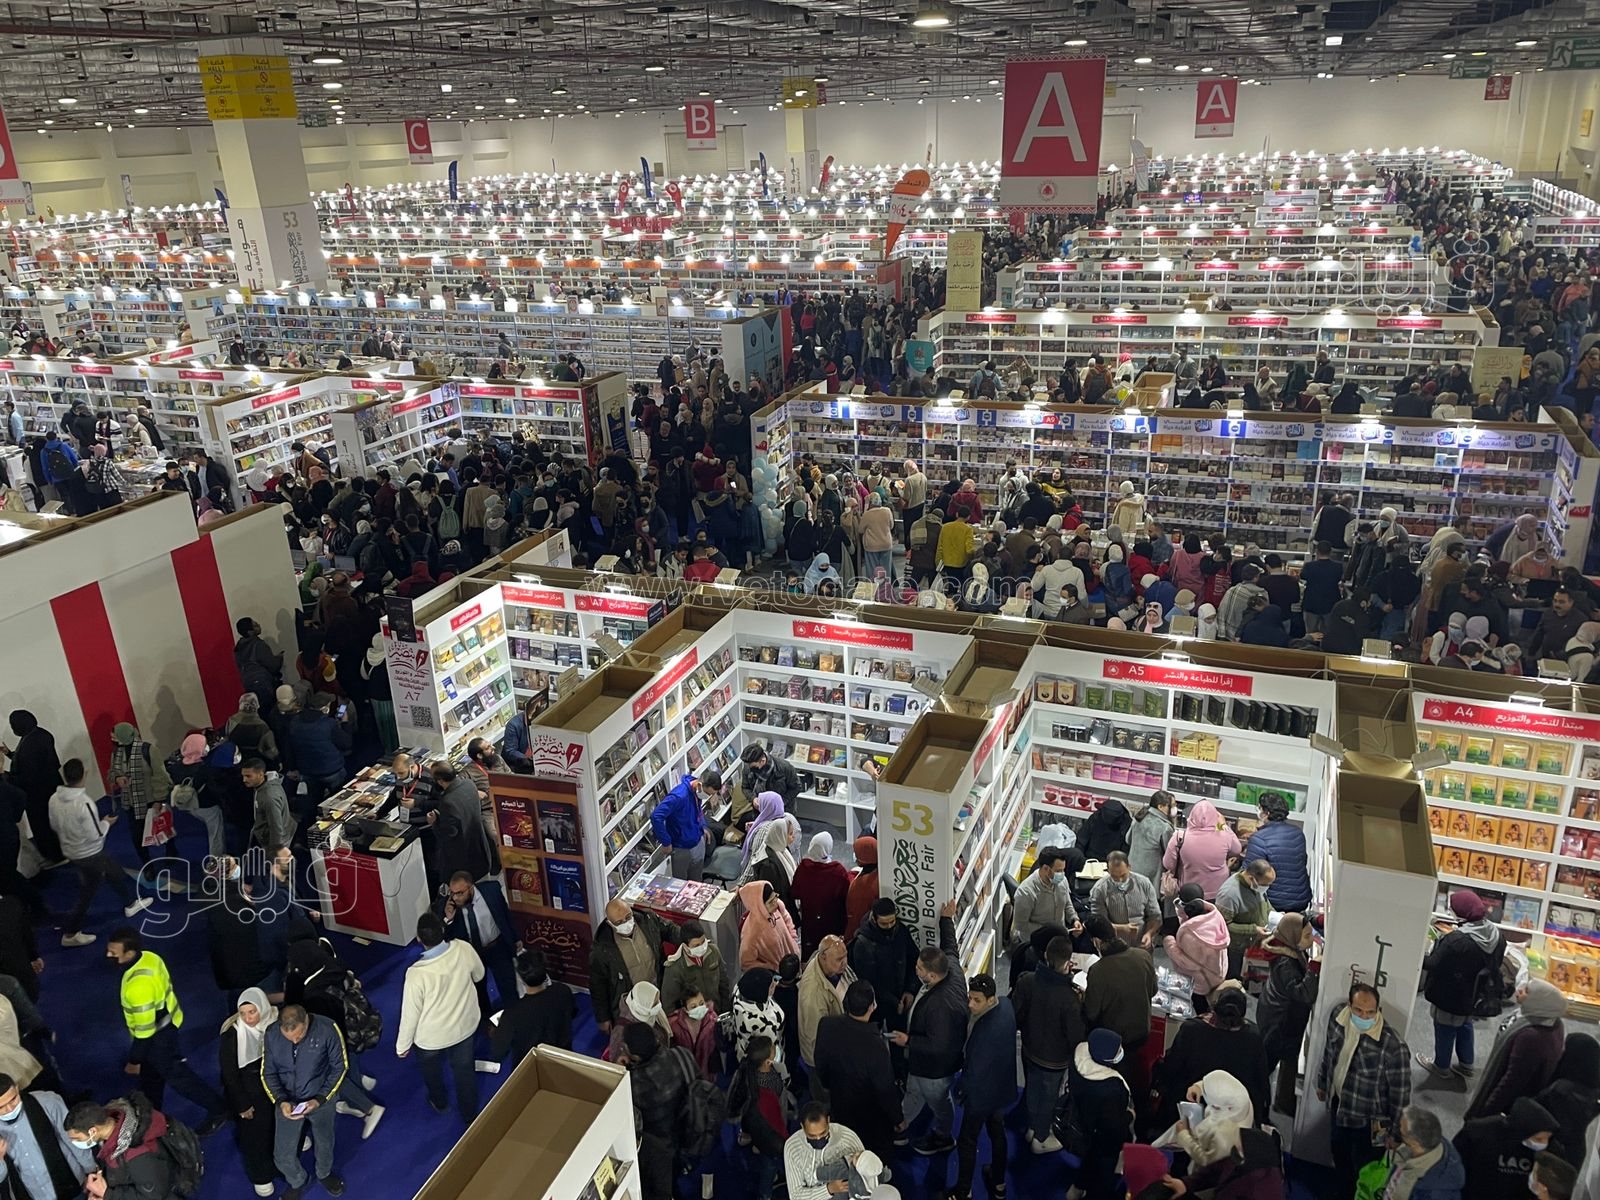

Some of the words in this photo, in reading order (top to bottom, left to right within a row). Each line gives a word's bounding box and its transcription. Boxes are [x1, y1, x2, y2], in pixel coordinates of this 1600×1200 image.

[1200, 84, 1231, 120] A
[691, 104, 711, 135] B
[1012, 71, 1088, 163] A
[410, 122, 428, 151] C
[282, 211, 299, 229] 53
[592, 598, 604, 607] A7
[813, 624, 827, 634] A6
[1128, 665, 1145, 676] A5
[1163, 671, 1189, 682] والنشر
[1190, 672, 1219, 684] للطباعة
[404, 691, 421, 701] A7
[1454, 705, 1475, 718] A4
[1495, 713, 1531, 726] والتوزيع
[1532, 716, 1560, 728] للنشر
[1560, 718, 1585, 731] مبتدأ
[891, 800, 934, 837] 53
[920, 844, 935, 872] Fair
[923, 880, 935, 918] Book
